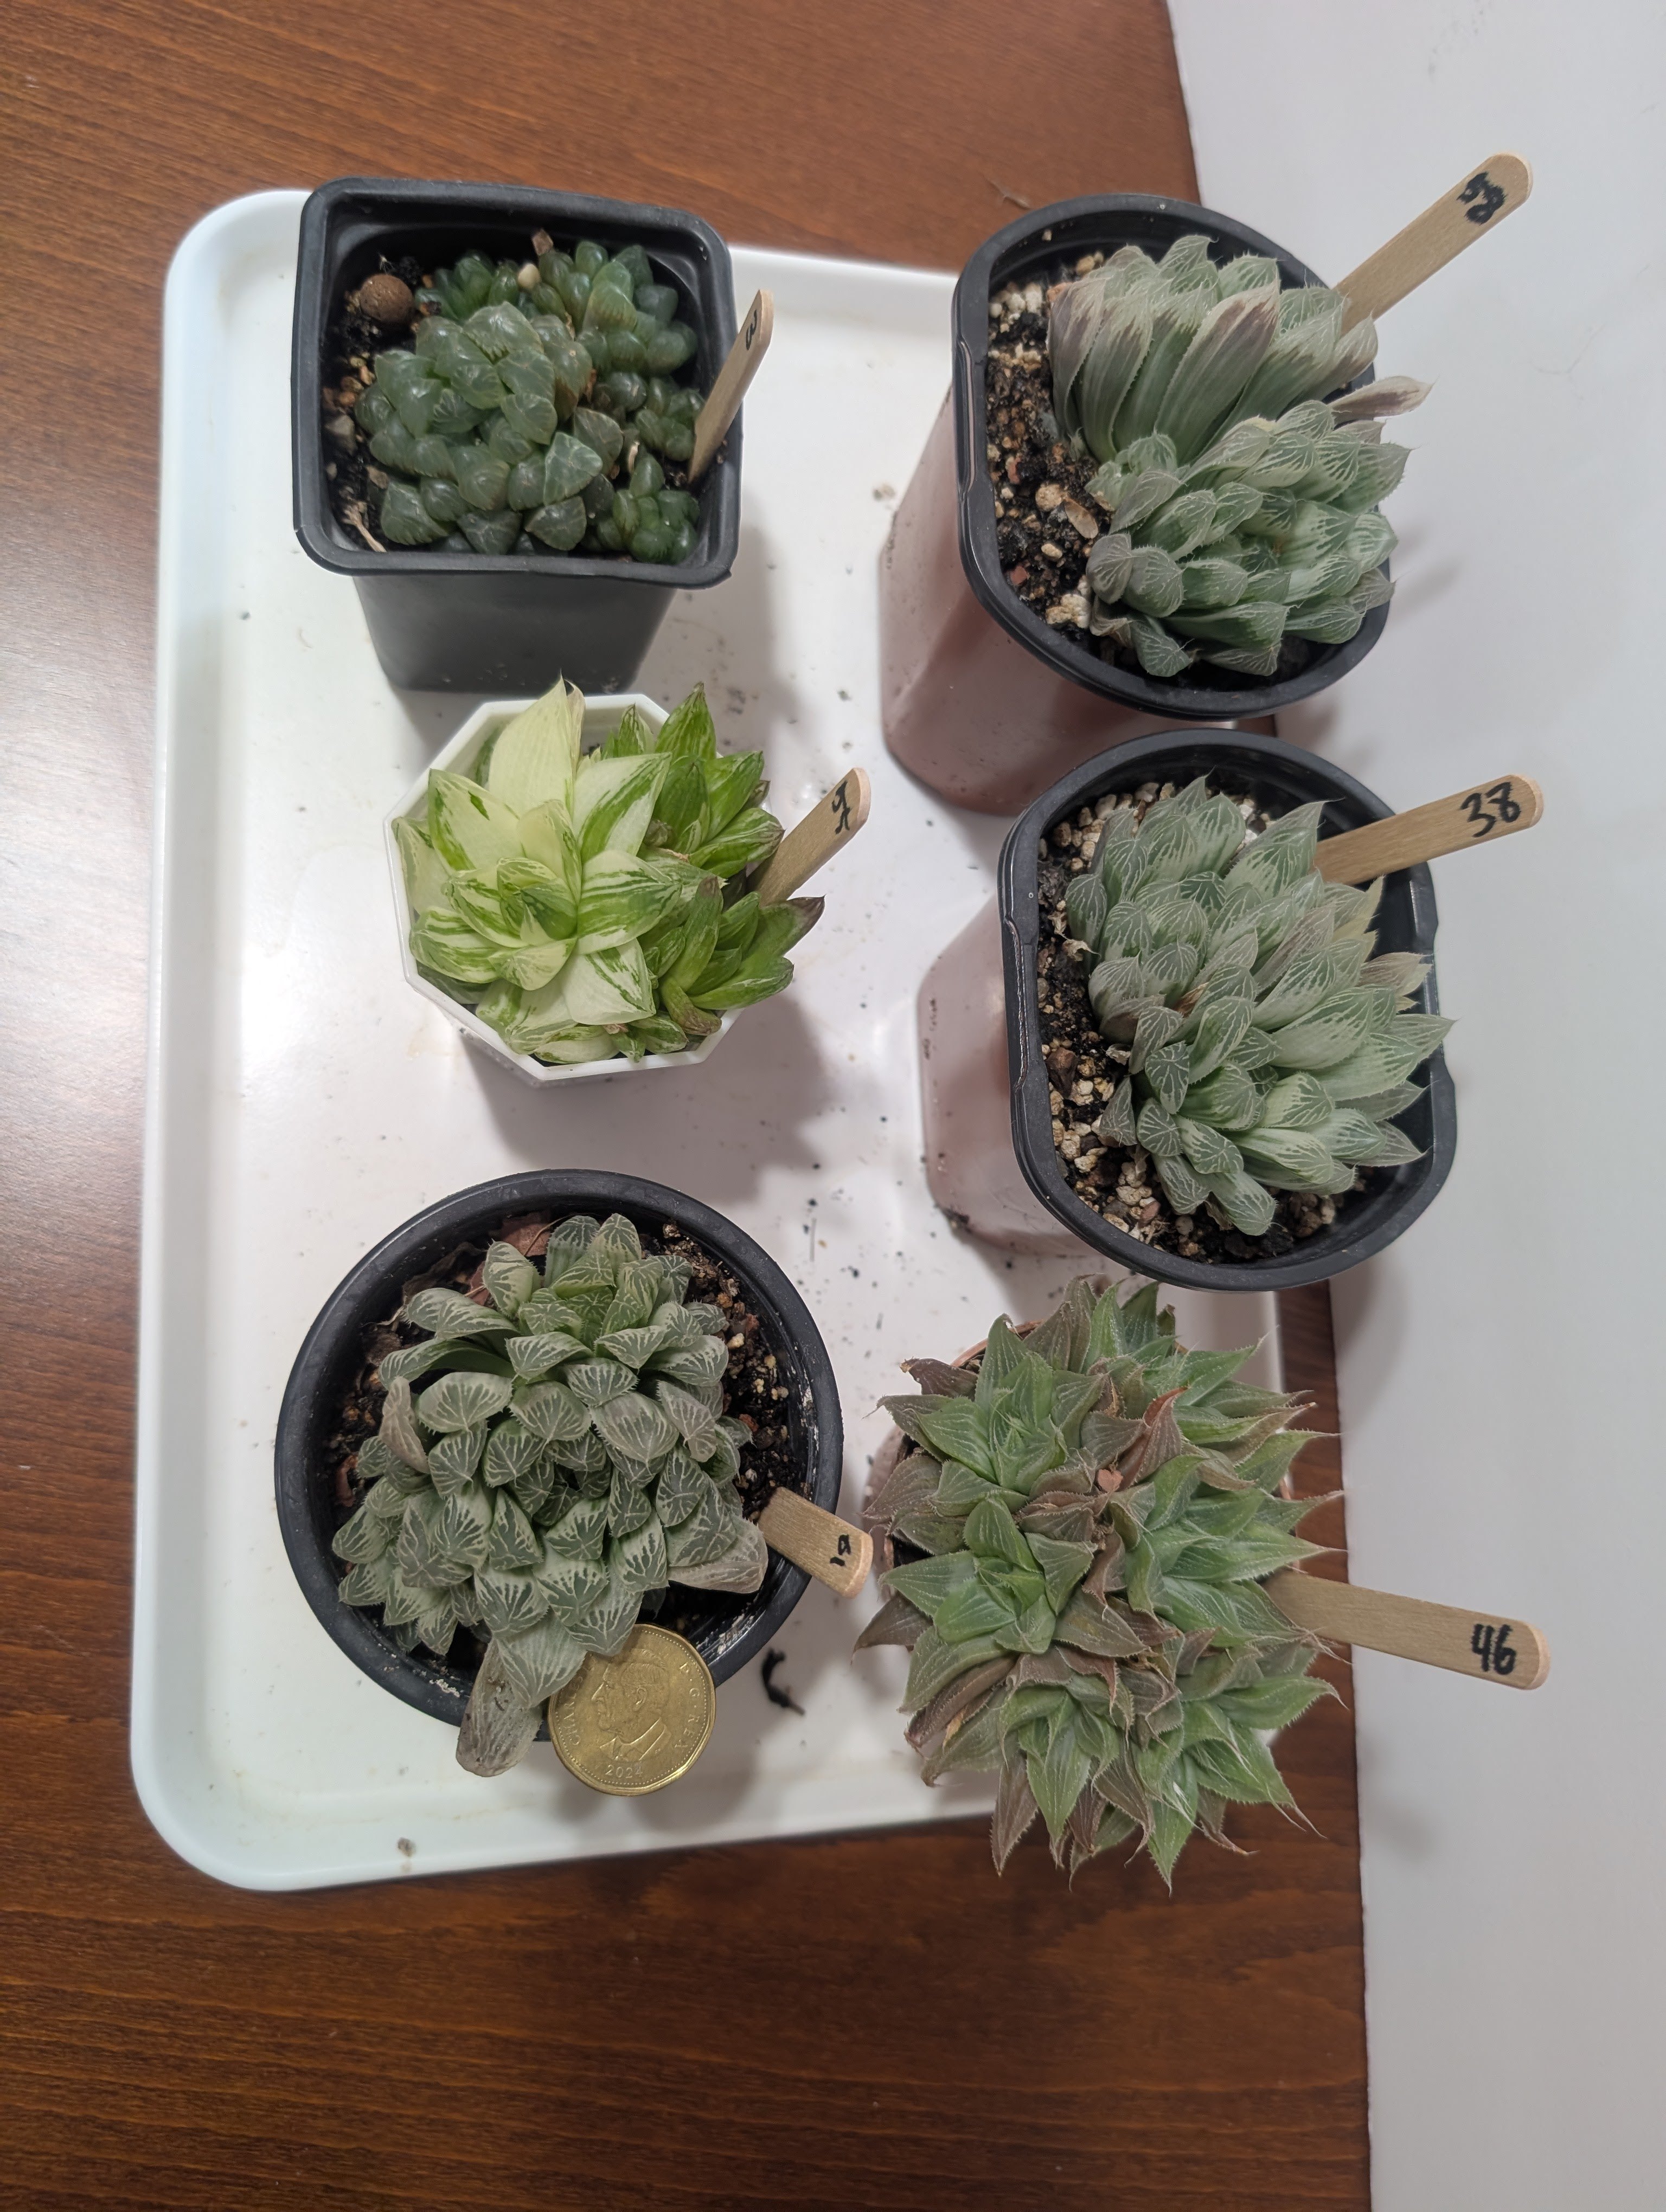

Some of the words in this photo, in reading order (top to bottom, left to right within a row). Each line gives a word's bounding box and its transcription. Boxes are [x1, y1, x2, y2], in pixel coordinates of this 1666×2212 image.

[1460, 782, 1521, 838] 38
[1471, 1624, 1516, 1675] 46
[605, 1764, 643, 1779] 2024
